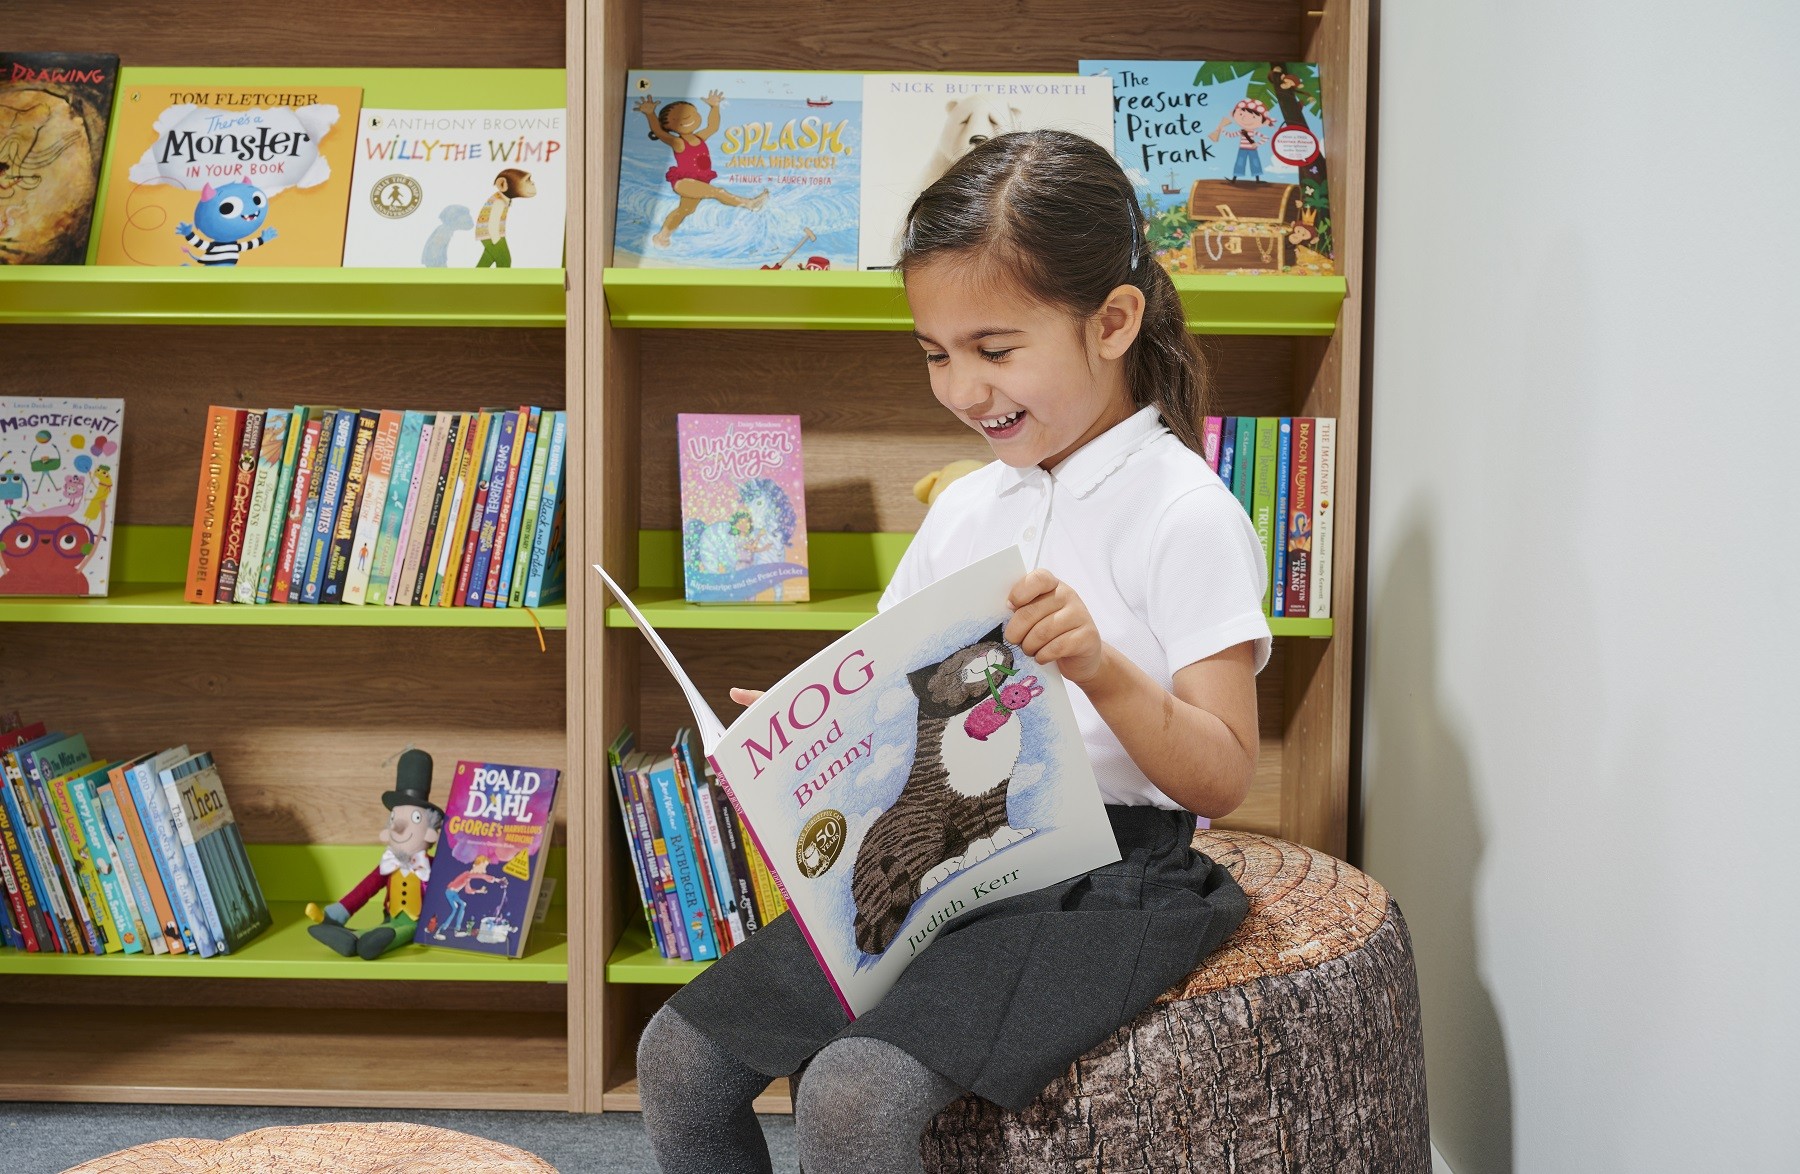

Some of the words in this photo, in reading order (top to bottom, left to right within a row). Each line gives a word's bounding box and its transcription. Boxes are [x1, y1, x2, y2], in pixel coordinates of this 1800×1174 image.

[11, 62, 105, 84] DRAWING
[890, 82, 934, 93] NICK
[946, 83, 1086, 95] BUTTERWORTH
[1117, 71, 1149, 87] The
[170, 93, 209, 106] TOM
[215, 93, 319, 107] FLETCHER
[1113, 91, 1208, 113] reasure
[205, 113, 250, 134] There's
[253, 116, 264, 124] a
[387, 117, 477, 131] ANTHONY
[483, 117, 560, 130] BROWNE
[721, 115, 852, 156] SPLASH,
[1127, 113, 1203, 142] Pirate
[158, 127, 311, 163] Monster
[439, 143, 482, 162] THE
[1142, 138, 1216, 172] Frank
[187, 166, 200, 178] IN
[206, 164, 243, 176] YOUR
[250, 162, 285, 175] BOOK
[725, 156, 766, 169] ANNA
[729, 174, 763, 184] ATINUKE
[777, 175, 807, 185] LAUREN
[809, 176, 832, 185] TOBIA
[242, 413, 253, 448] COWELL
[250, 413, 260, 449] CRESSIDA
[334, 419, 350, 447] SUPER
[358, 417, 375, 428] THE
[553, 422, 564, 444] DAVID
[1260, 423, 1274, 451] TERRY
[1321, 423, 1330, 442] THE
[315, 429, 329, 466] Silver
[347, 428, 373, 482] NOWHERE
[372, 430, 387, 461] LAIRD
[379, 421, 399, 474] ELIZABETH
[494, 443, 510, 473] TEAMS
[688, 427, 794, 462] Unicorn
[1298, 423, 1309, 463] DRAGON
[459, 456, 469, 477] STREET
[548, 444, 561, 476] OLUSOGA
[701, 446, 784, 481] Magic
[1319, 446, 1329, 495] IMAGINARY
[291, 467, 309, 503] Loser
[308, 465, 323, 499] Sword
[322, 469, 341, 506] FREDDIE
[505, 466, 516, 489] Looking
[1257, 455, 1273, 500] PRATCHETT
[1294, 465, 1307, 508] MOUNTAIN
[249, 469, 267, 527] DRAGONS
[371, 480, 387, 524] WELCOME
[485, 473, 505, 515] TERRIFIC
[503, 489, 512, 503] after
[202, 494, 216, 528] DAVID
[226, 483, 249, 557] DRAGON
[317, 505, 332, 533] YATES
[335, 481, 361, 541] EMPORIUM
[470, 502, 483, 531] ALISSON
[523, 517, 532, 533] TERRY
[538, 496, 553, 527] Black
[287, 522, 300, 549] Barry
[492, 531, 505, 560] Puppies
[521, 533, 529, 548] DEARY
[195, 531, 211, 583] BADDIEL
[282, 548, 293, 572] Loser
[529, 546, 545, 578] British
[415, 572, 424, 594] OXFORD
[733, 581, 746, 589] and
[746, 577, 758, 585] the
[778, 567, 804, 576] Locket
[1291, 559, 1299, 591] TSANG
[741, 649, 875, 780] MOG
[794, 719, 845, 771] and
[137, 769, 151, 791] ODD
[469, 768, 541, 795] ROALD
[716, 772, 728, 785] MOG
[792, 732, 875, 809] Bunny
[182, 785, 224, 822] Then
[722, 783, 735, 797] AND
[728, 795, 745, 816] BUNNY
[51, 780, 72, 816] Barry
[65, 816, 81, 845] Loser
[71, 782, 93, 819] Barry
[84, 818, 103, 850] Loser
[170, 804, 185, 828] Then
[464, 791, 534, 823] DAHL
[701, 793, 713, 820] RABBIT
[708, 825, 719, 844] BEAR
[833, 812, 843, 821] CAT
[449, 815, 503, 838] GEORGE'S
[816, 821, 837, 848] 50
[821, 832, 840, 852] YEARS
[2, 868, 16, 892] STUFF
[4, 830, 17, 851] ARE
[11, 851, 36, 908] AWESOME
[122, 846, 136, 871] HOTEL
[130, 871, 150, 914] FLAMINGO
[669, 833, 699, 908] RATBURGER
[80, 872, 93, 891] Jim
[87, 891, 104, 922] Smith
[738, 877, 748, 894] THIEF
[101, 879, 115, 900] Jim
[109, 899, 127, 932] Smith
[738, 893, 757, 931] Diamond
[907, 897, 966, 957] Judith
[970, 867, 1021, 901] Kerr
